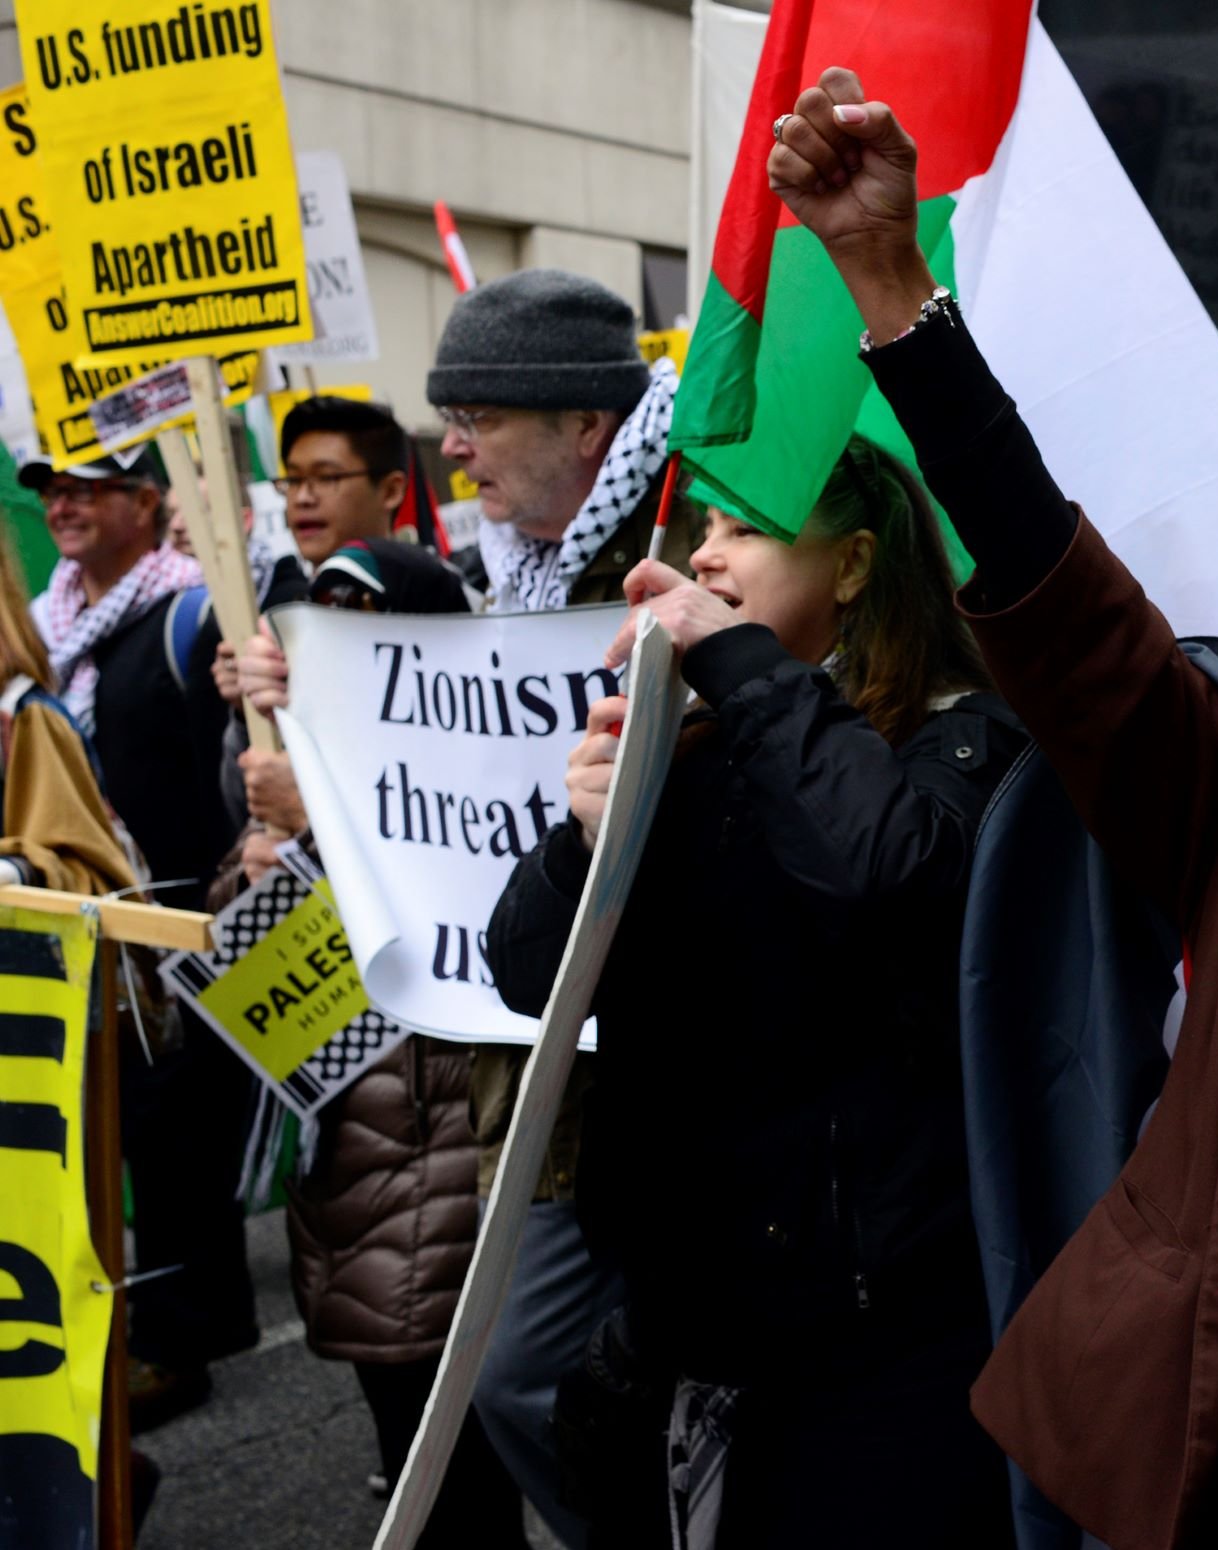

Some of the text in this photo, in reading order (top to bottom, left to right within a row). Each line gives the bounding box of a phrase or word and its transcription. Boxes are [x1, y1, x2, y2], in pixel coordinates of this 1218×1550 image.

[36, 3, 262, 90] U.S. funding
[4, 98, 36, 156] S
[84, 122, 257, 203] of Israeli
[91, 215, 278, 296] Apartheid
[89, 286, 297, 346] AnswerCoalition.org
[374, 761, 566, 861] threat
[291, 906, 335, 947] SUP
[242, 928, 354, 1036] PALES
[298, 976, 361, 1031] HUMA
